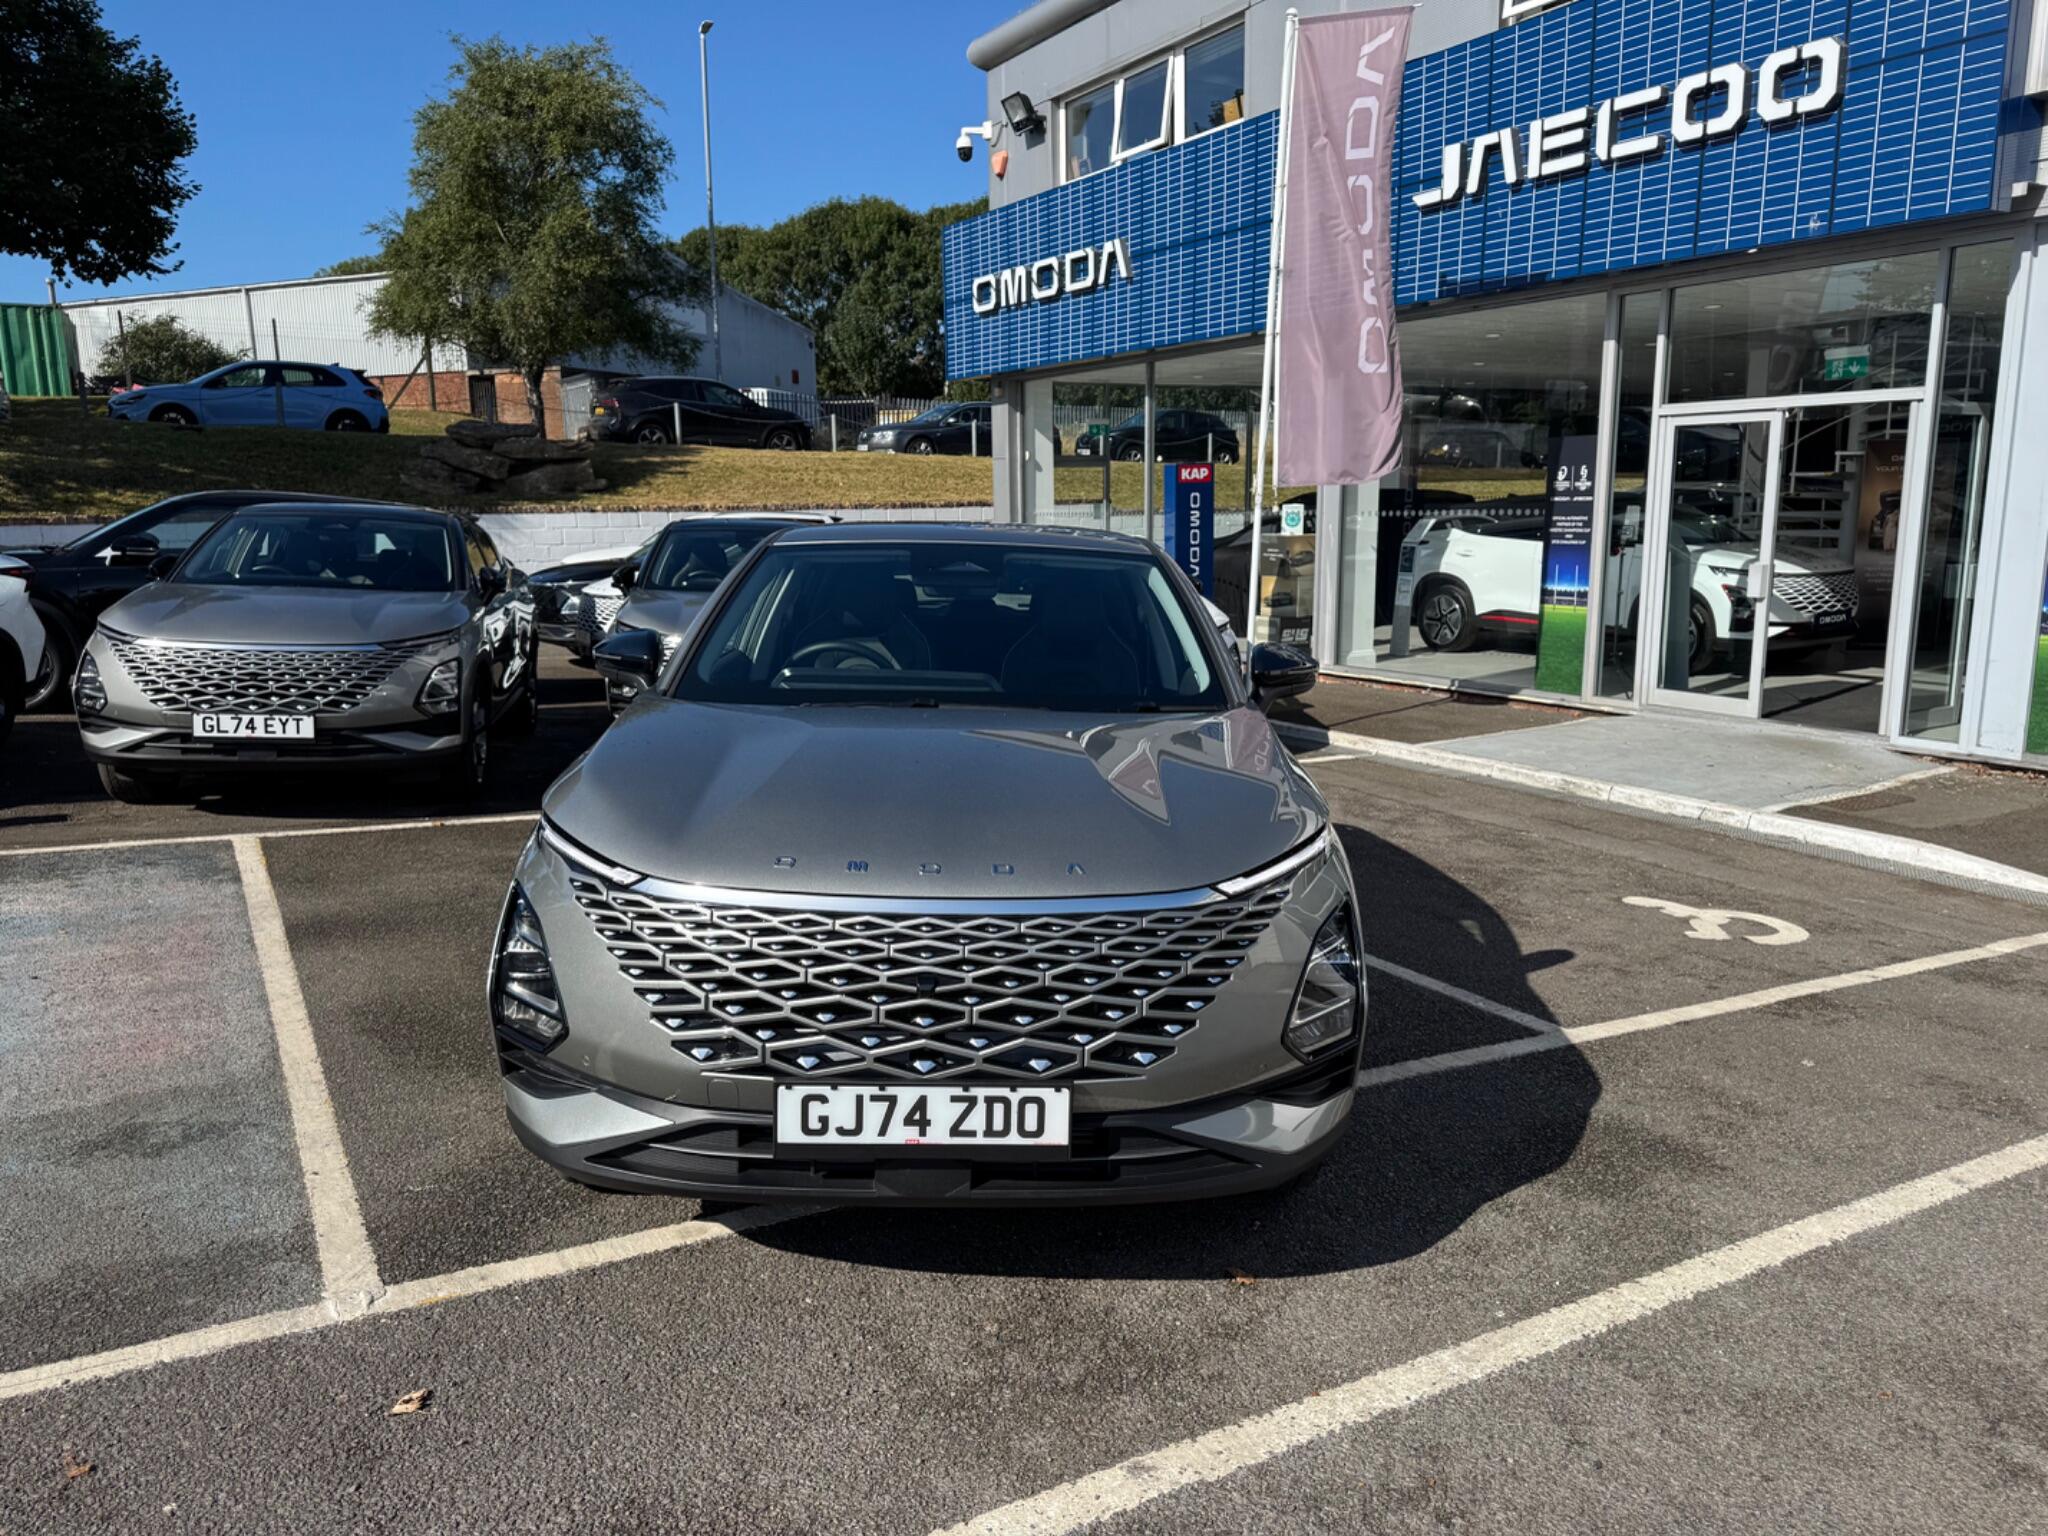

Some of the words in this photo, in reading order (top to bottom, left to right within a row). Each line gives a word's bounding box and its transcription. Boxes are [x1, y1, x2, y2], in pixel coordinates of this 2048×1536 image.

[1411, 35, 1848, 211] JAECOO
[1345, 26, 1395, 374] OMODA
[971, 238, 1132, 316] OMODA
[1181, 468, 1209, 480] KAP
[1189, 491, 1201, 576] OMODA
[202, 716, 257, 734] GL74
[264, 717, 304, 735] EYT
[773, 855, 1086, 876] OMODA
[800, 1093, 931, 1138] GJ74
[949, 1095, 1046, 1139] ZDO
